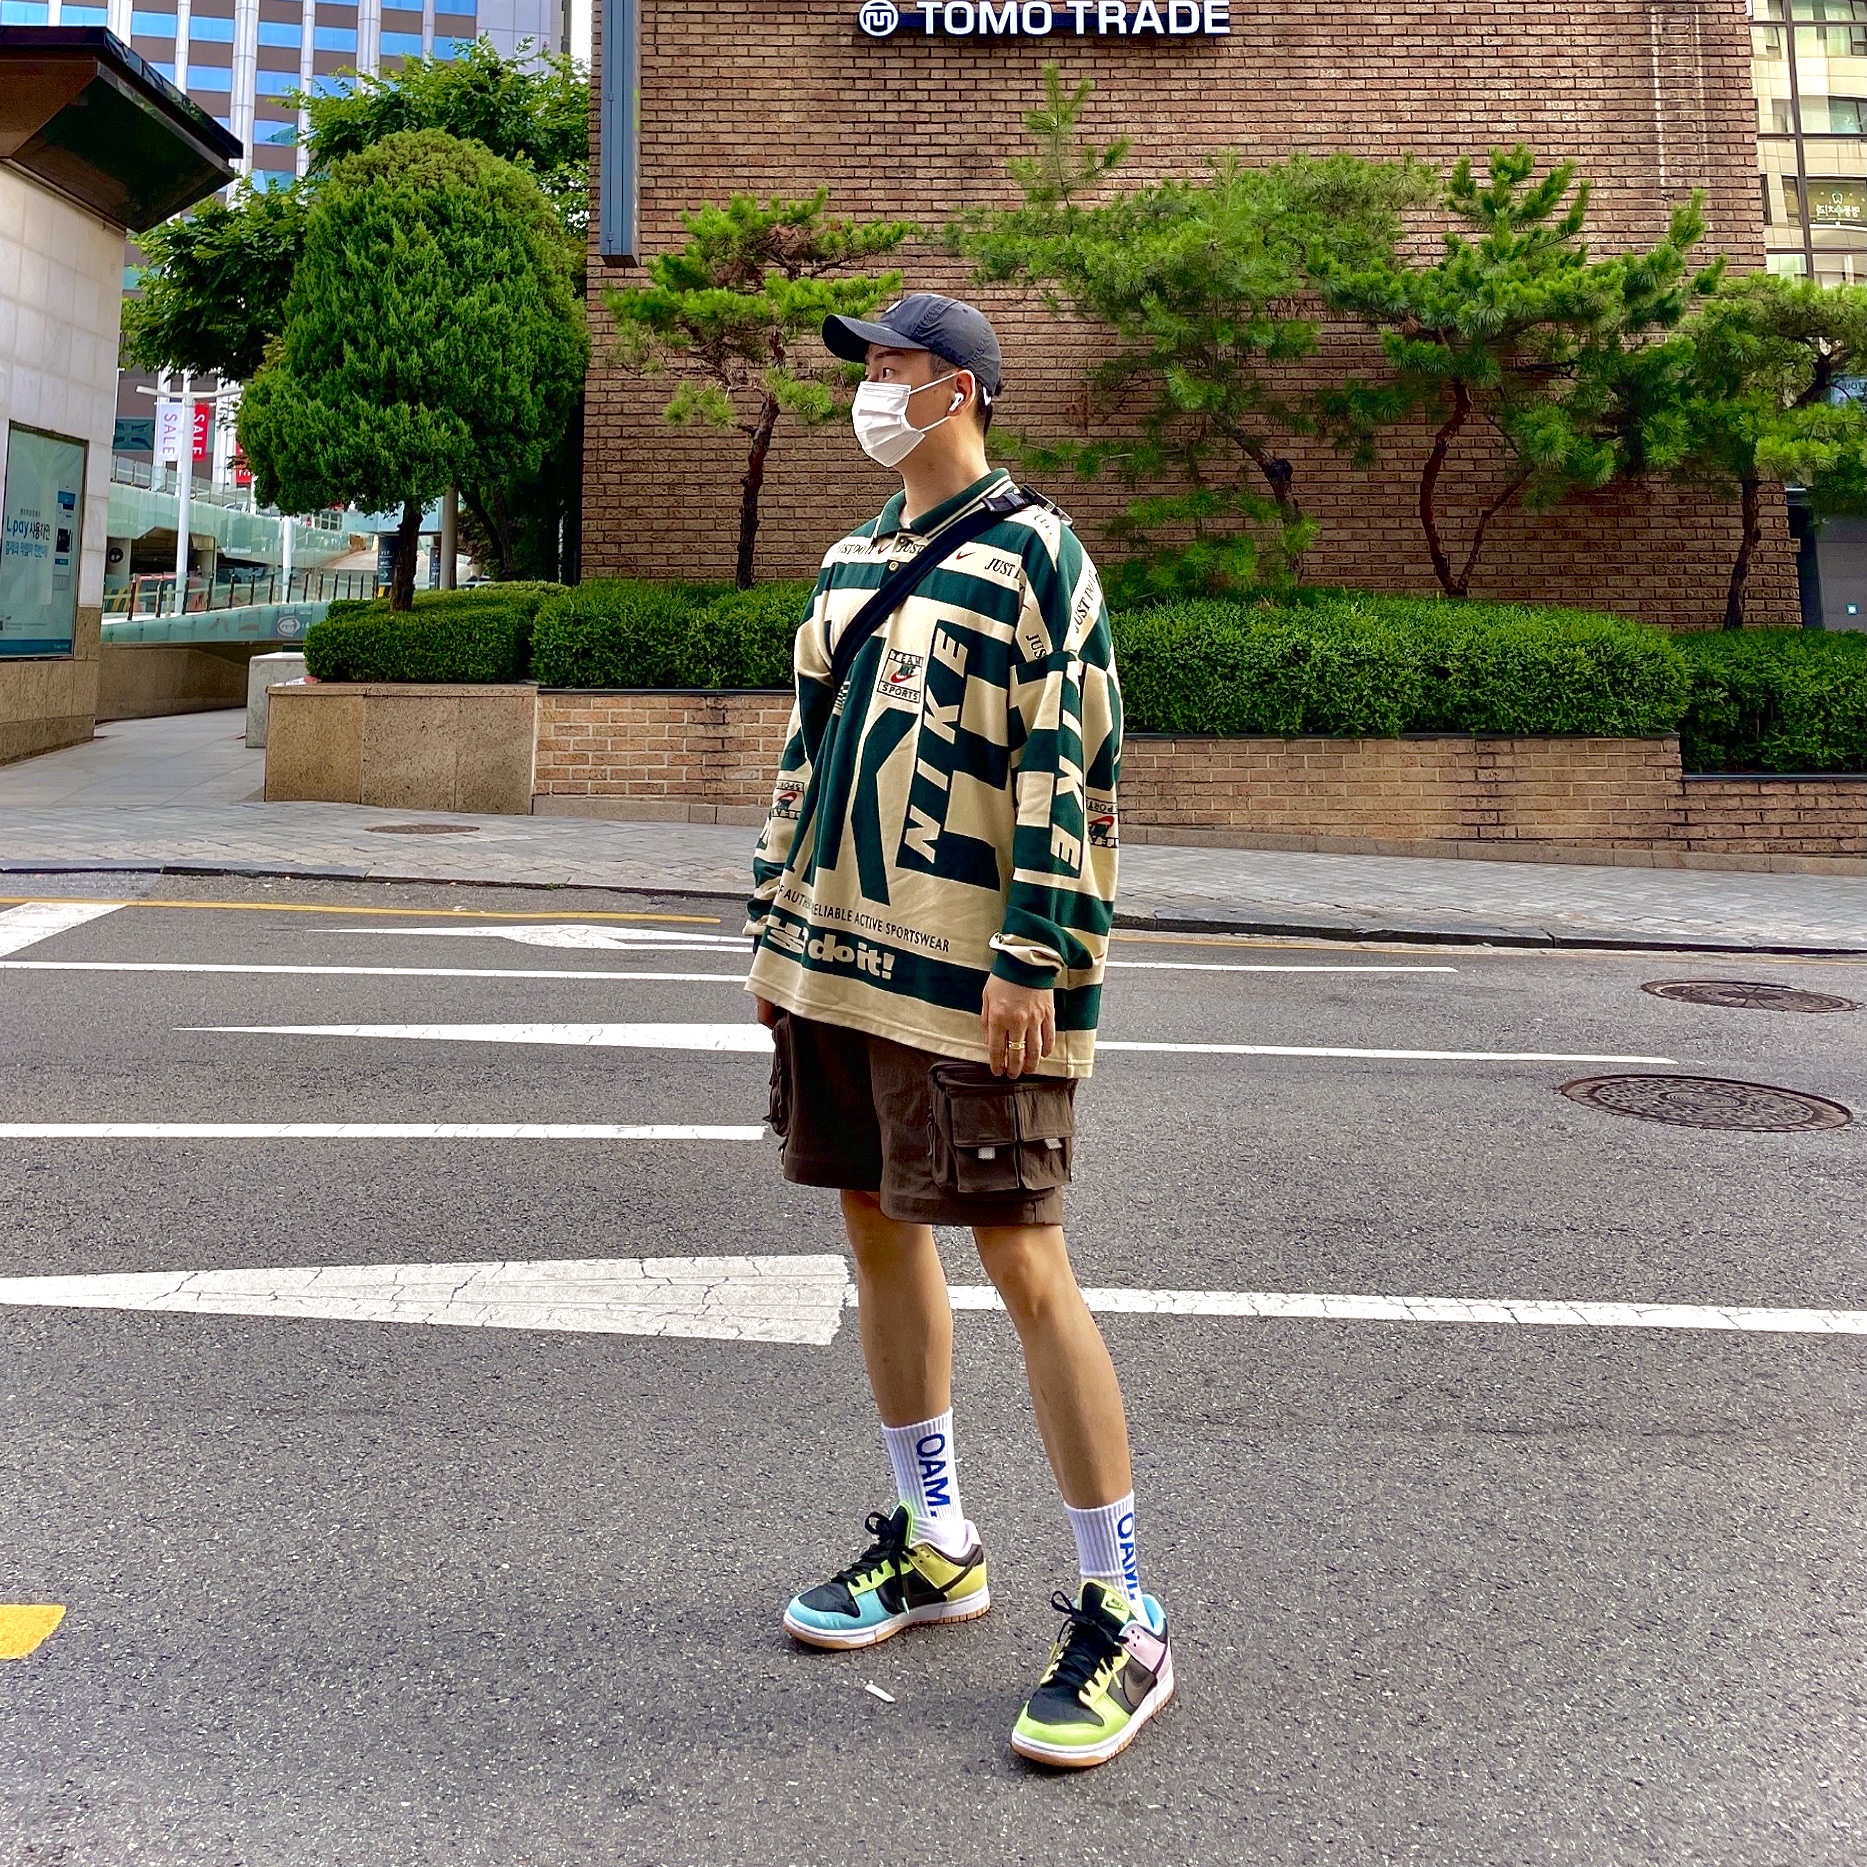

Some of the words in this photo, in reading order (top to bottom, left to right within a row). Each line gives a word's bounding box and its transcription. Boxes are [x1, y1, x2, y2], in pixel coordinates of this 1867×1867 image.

[916, 0, 1053, 35] TOMO
[1066, 0, 1231, 35] TRADE
[162, 413, 178, 455] SALE
[985, 558, 1016, 576] JUST
[889, 650, 924, 667] TEAM
[1025, 633, 1047, 659] JUS
[881, 684, 919, 701] SPORTS
[904, 628, 968, 864] NIKE
[811, 903, 853, 923] ELIABLE
[853, 912, 883, 933] ACTIVE
[885, 922, 950, 953] SPORTSWEAR
[916, 1433, 951, 1518] OAM.
